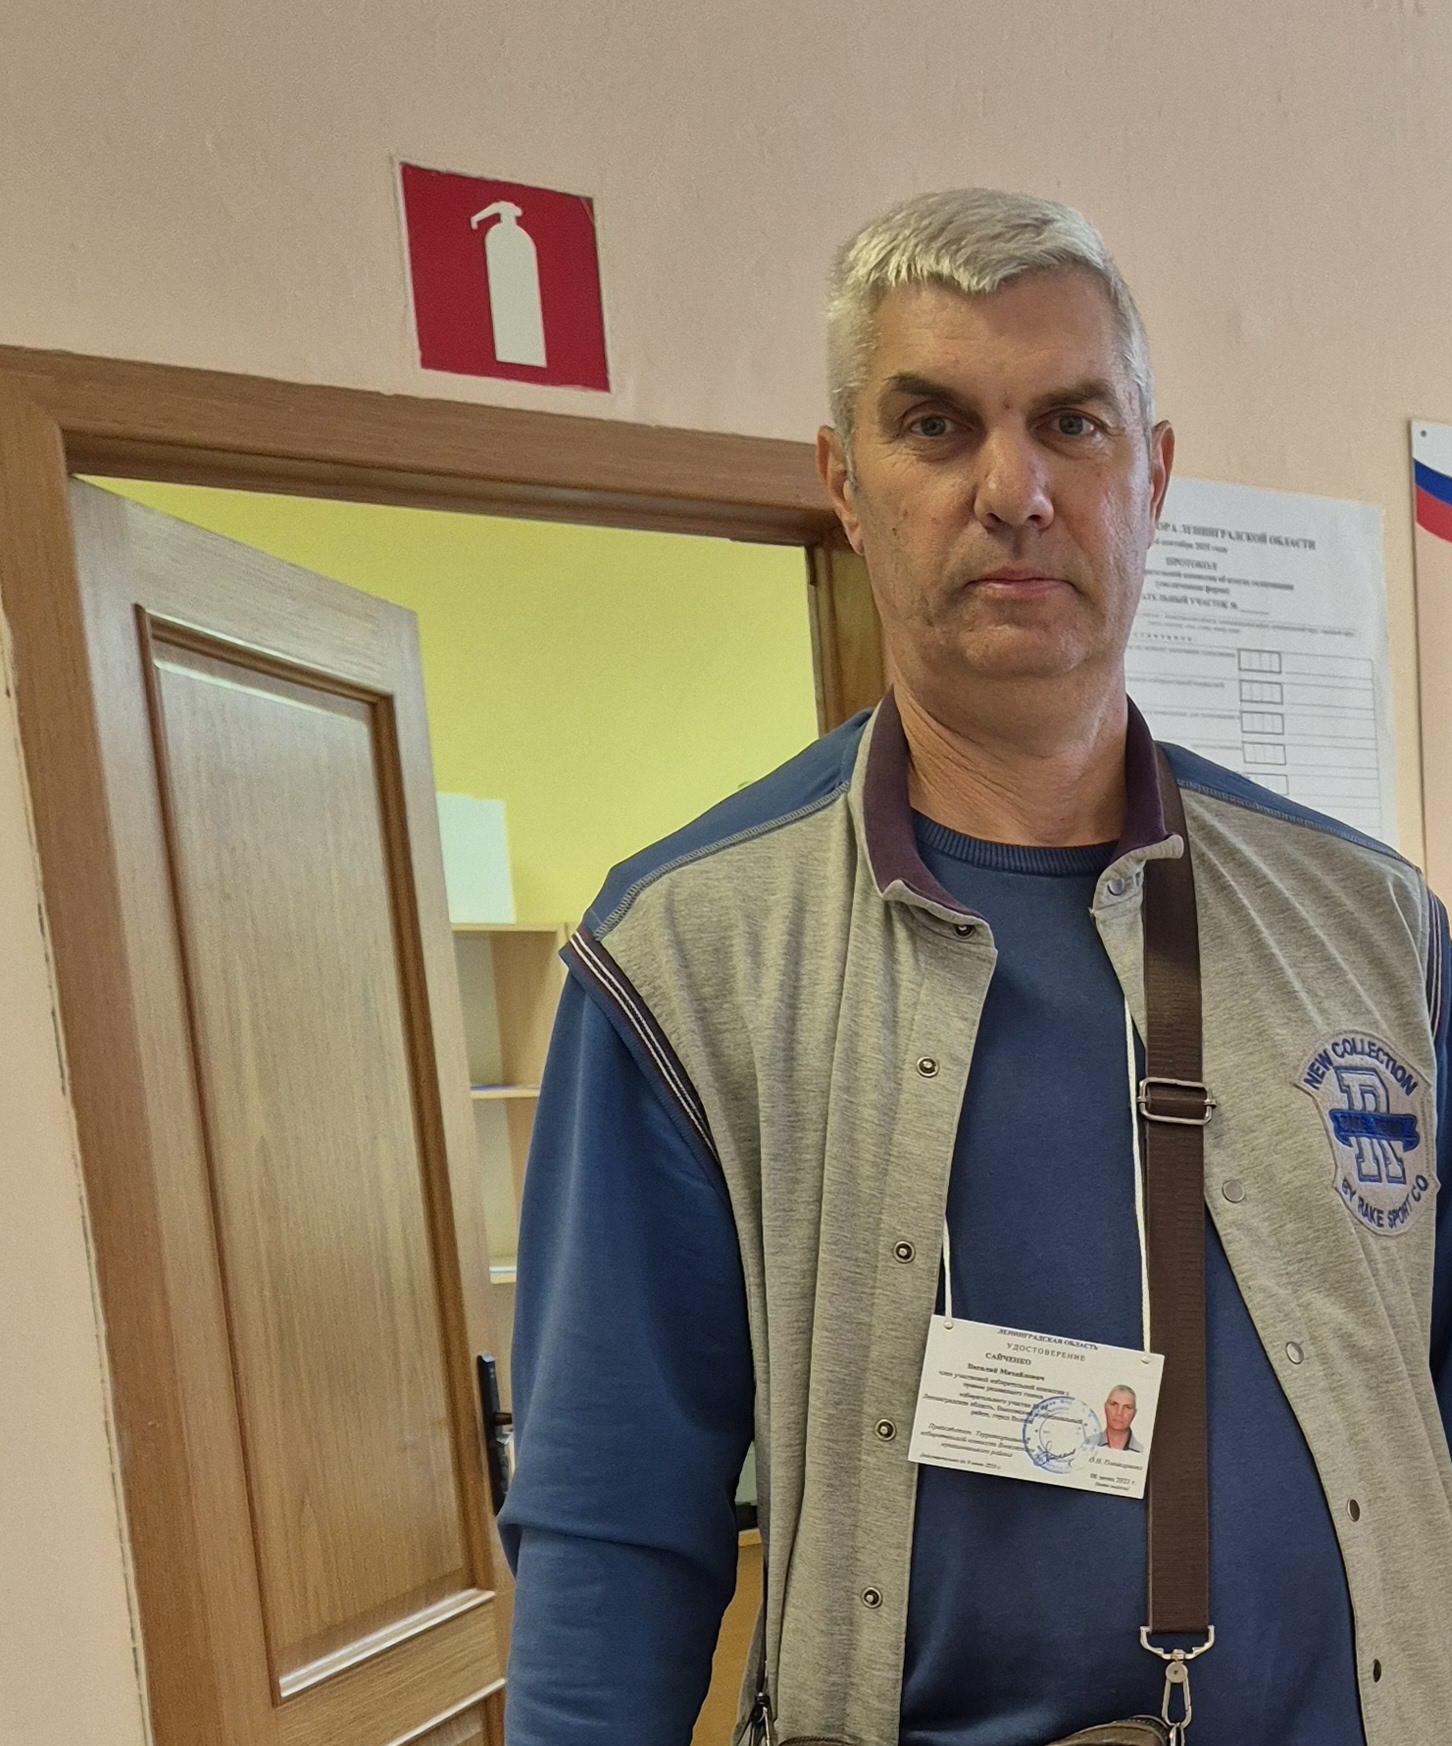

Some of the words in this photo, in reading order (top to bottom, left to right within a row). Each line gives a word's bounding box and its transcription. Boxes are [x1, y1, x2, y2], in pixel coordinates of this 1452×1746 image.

[1303, 1050, 1335, 1091] NEW
[1331, 1037, 1419, 1096] COLLECTION
[1340, 1175, 1356, 1201] BY
[1387, 1193, 1415, 1229] SPORT
[1411, 1174, 1430, 1203] CO
[997, 1328, 1063, 1345] ЛЕНИНГРАДСКАЯ
[1063, 1339, 1099, 1351] ОБЛАСТЬ
[985, 1352, 1032, 1366] САЙЧЕНКО
[1006, 1342, 1086, 1362] УДОСТОВЕРЕНИЕ
